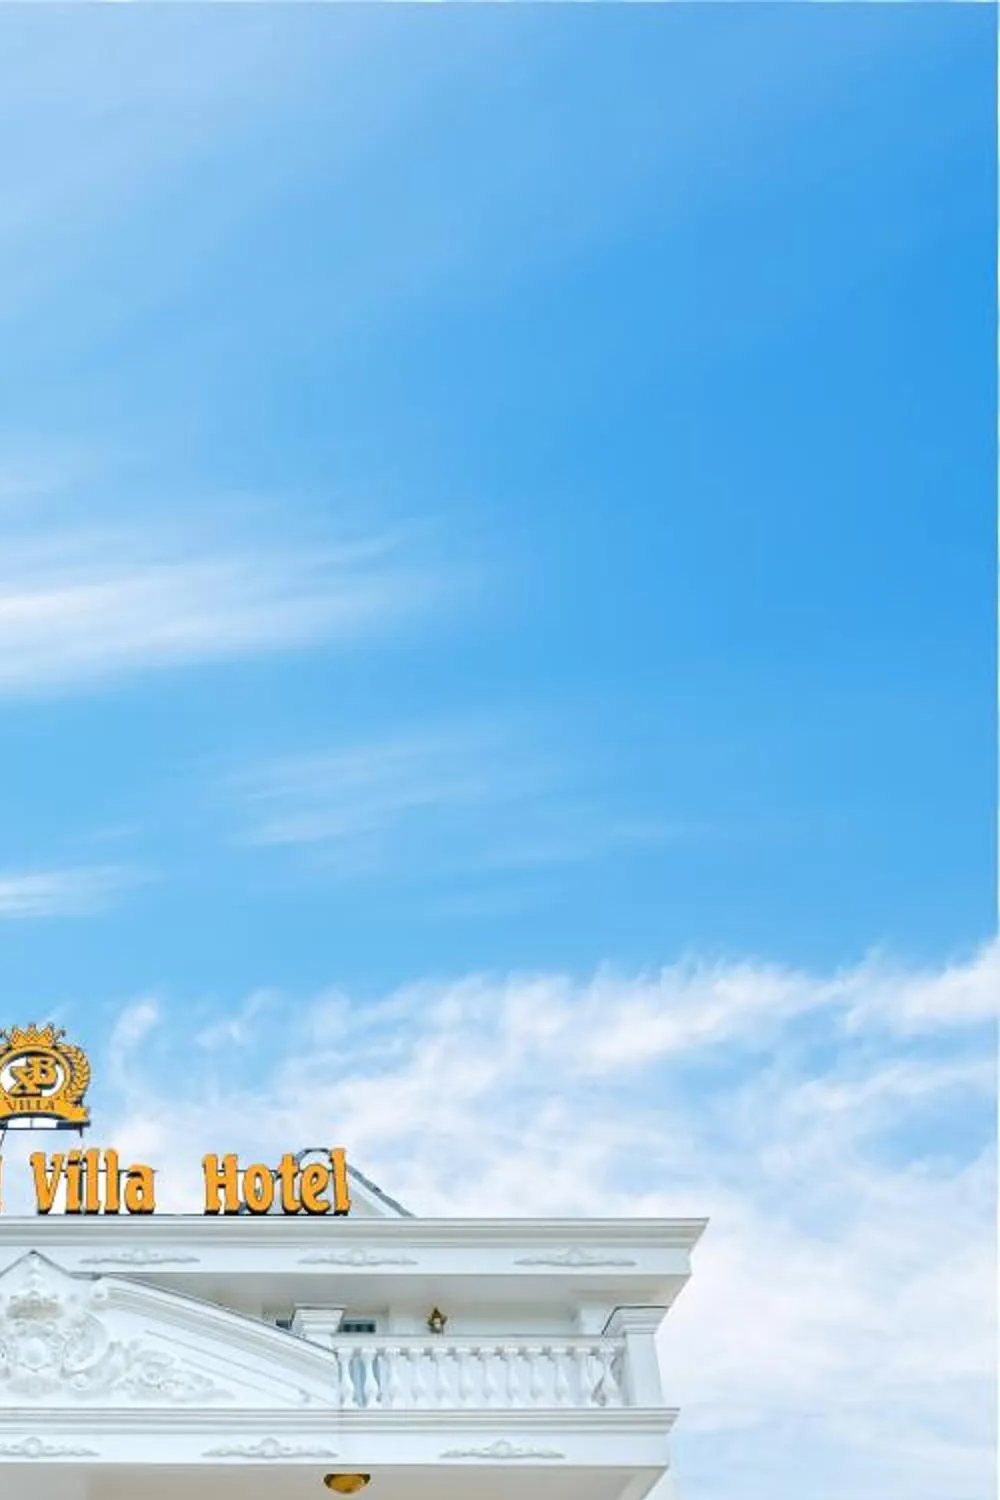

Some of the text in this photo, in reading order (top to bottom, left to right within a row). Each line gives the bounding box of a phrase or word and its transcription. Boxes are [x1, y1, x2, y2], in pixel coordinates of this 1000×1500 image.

[4, 1098, 56, 1112] VILLA
[29, 1147, 157, 1214] Villa
[202, 1147, 352, 1214] Hotel
